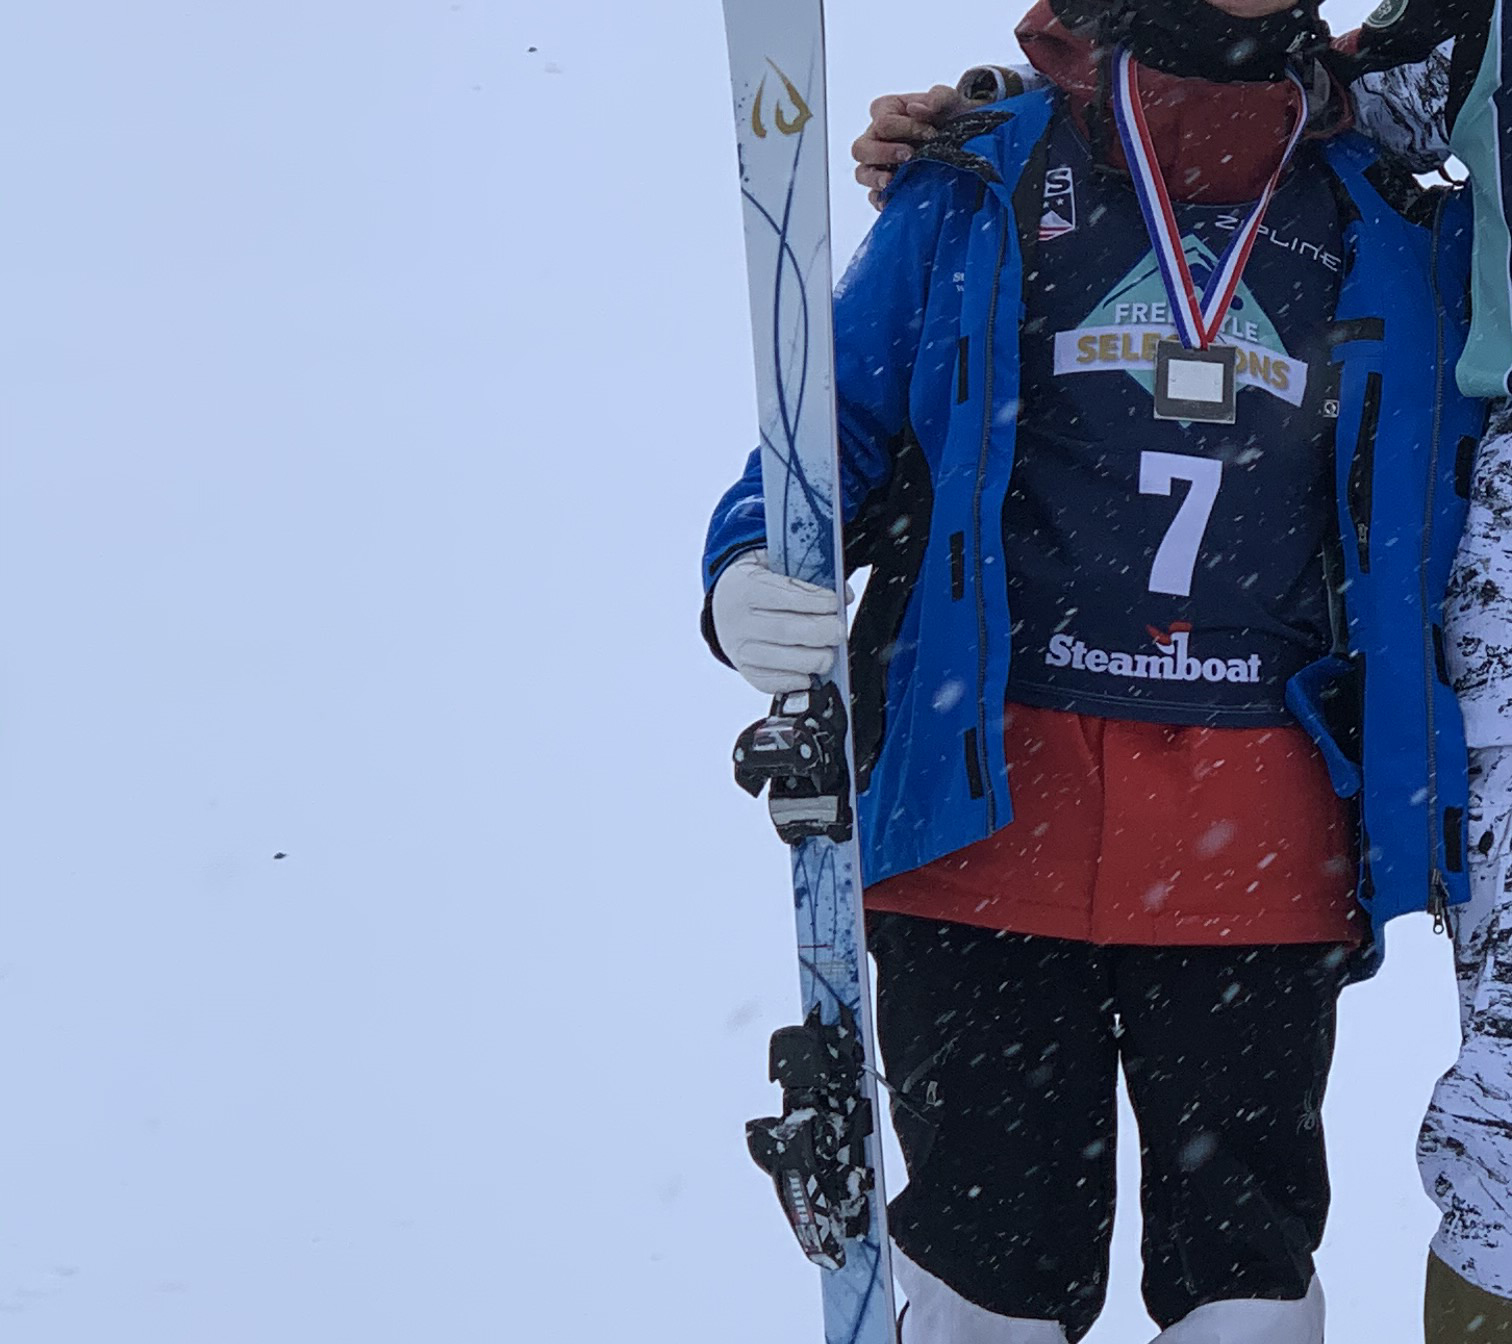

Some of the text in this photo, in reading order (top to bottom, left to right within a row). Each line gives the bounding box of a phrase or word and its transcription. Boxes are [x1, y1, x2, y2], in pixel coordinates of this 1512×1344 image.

[1046, 170, 1071, 194] S
[1214, 214, 1342, 272] ZPLINE
[1114, 301, 1260, 342] FREYLE
[1075, 332, 1291, 391] SELENS
[1139, 450, 1223, 597] 7
[1045, 630, 1262, 683] Steamboat
